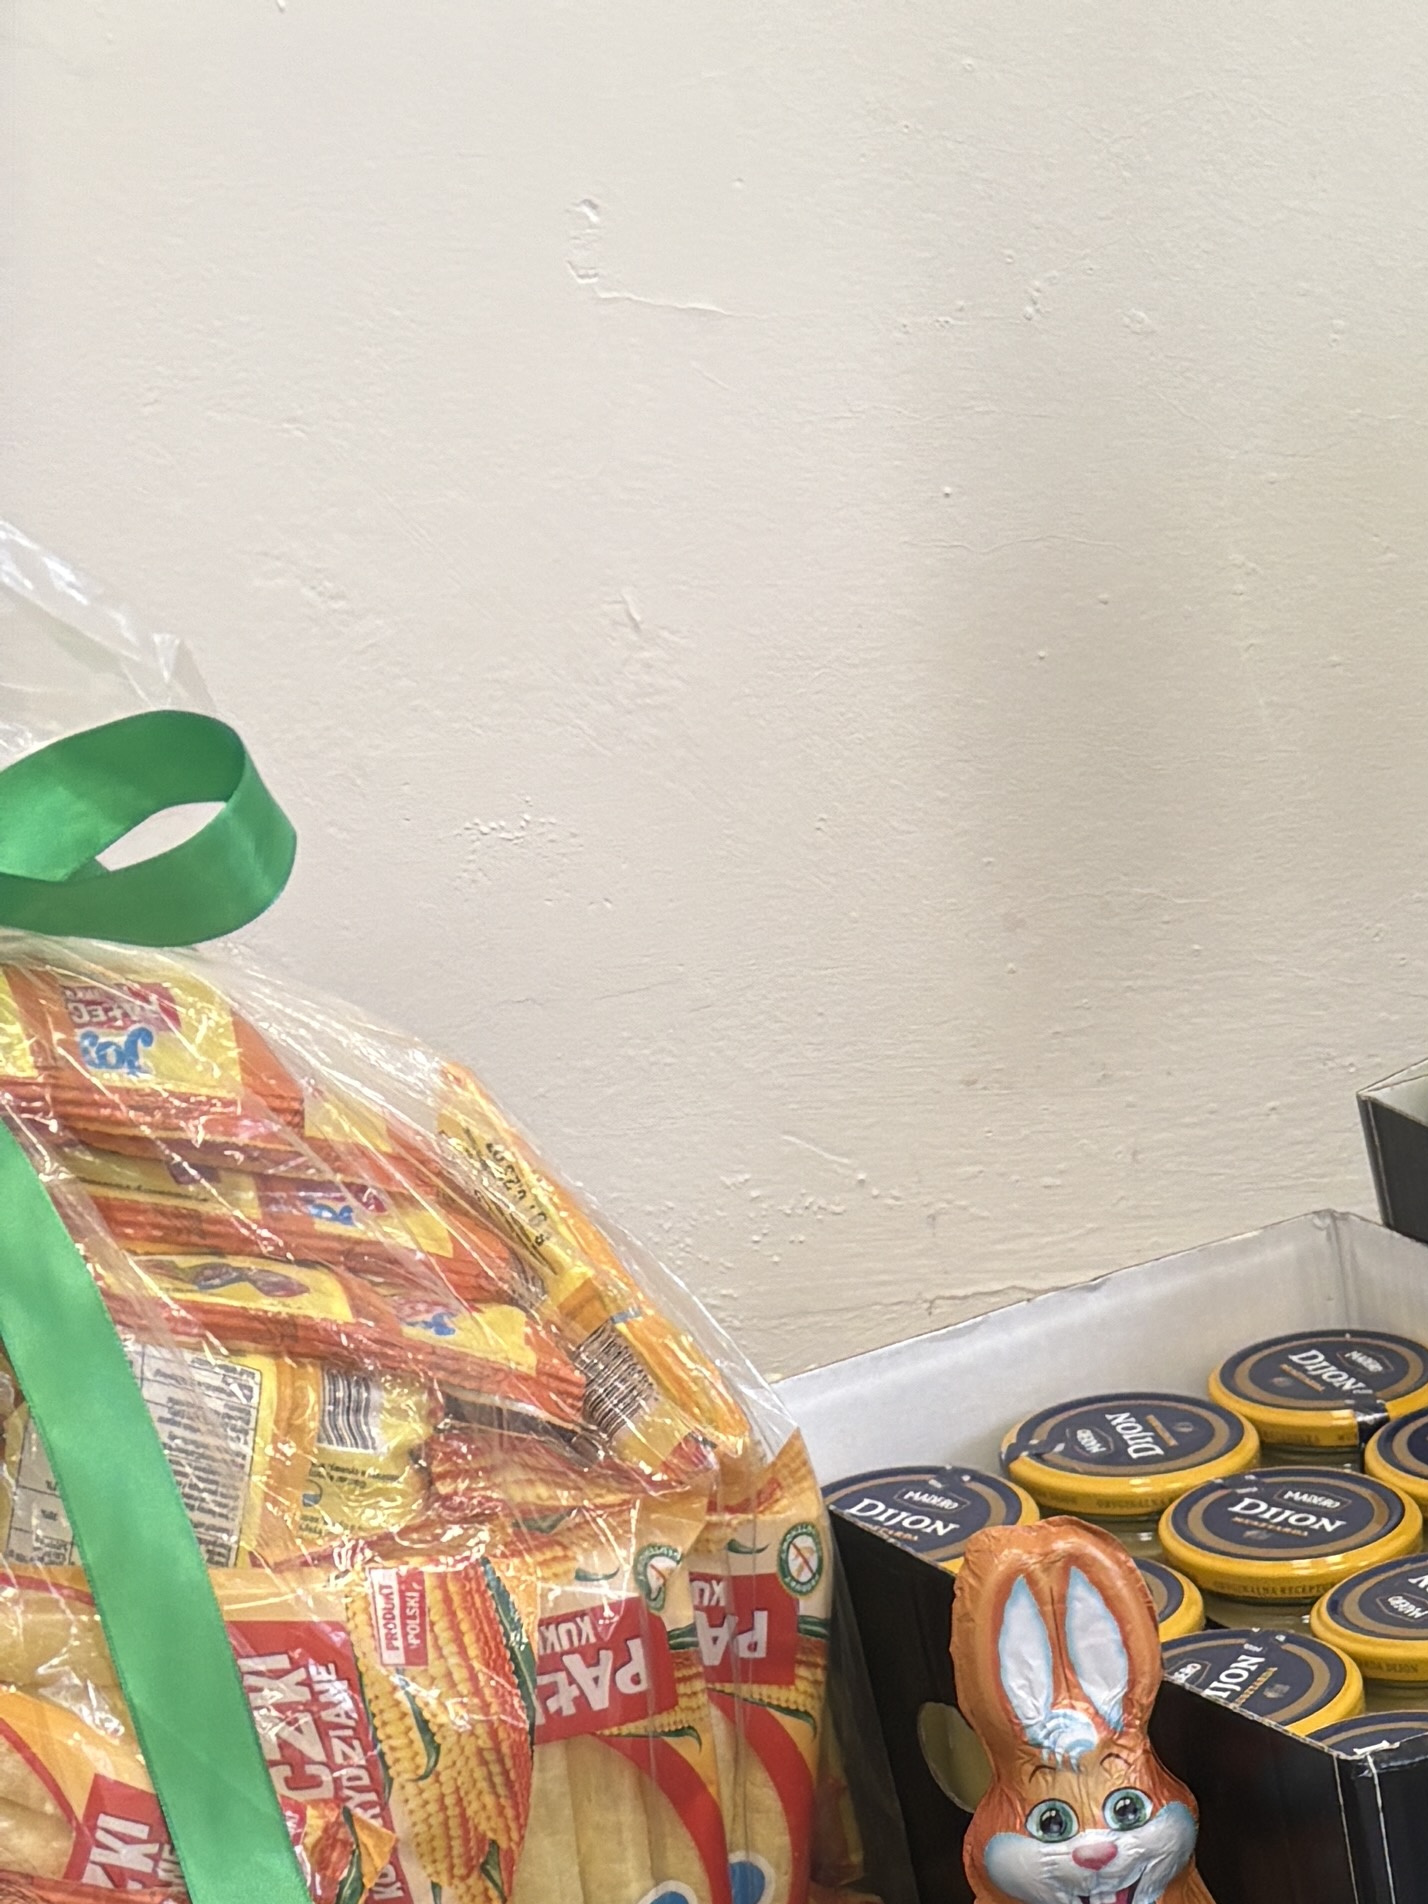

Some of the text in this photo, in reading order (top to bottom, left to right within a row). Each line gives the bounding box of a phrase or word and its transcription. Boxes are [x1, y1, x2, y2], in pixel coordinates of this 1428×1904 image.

[848, 1498, 961, 1538] DIJON
[1227, 1497, 1349, 1533] DIJON
[377, 1583, 399, 1651] PRODUKT
[406, 1592, 422, 1644] POLSKI
